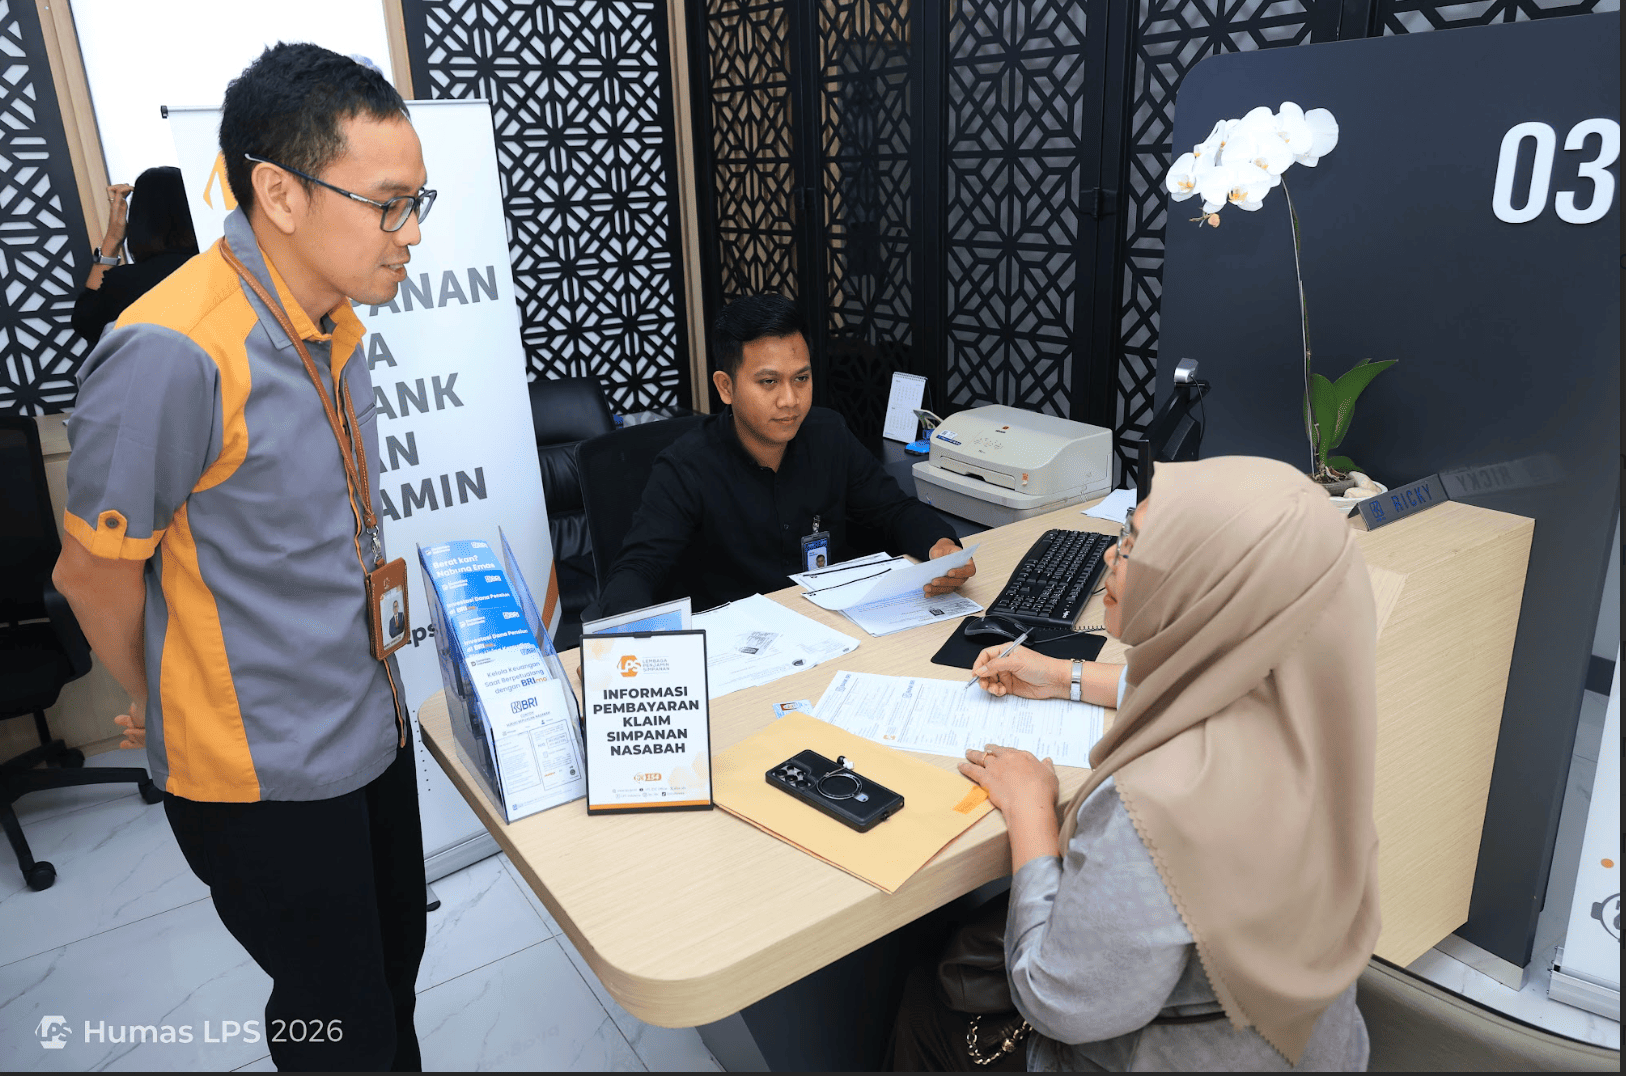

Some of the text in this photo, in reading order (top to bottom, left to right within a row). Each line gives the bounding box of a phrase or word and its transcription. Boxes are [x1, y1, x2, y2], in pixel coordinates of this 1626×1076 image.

[1492, 117, 1620, 224] 03
[1391, 484, 1433, 513] RICKY
[432, 555, 478, 569] Berat kan?
[486, 662, 541, 678] Kelola Keuangan
[617, 656, 641, 676] LPS
[484, 669, 545, 687] Saat Berpetualang
[494, 683, 521, 694] dengan
[603, 686, 688, 700] INFORMASI
[521, 696, 539, 710] BRI
[593, 700, 699, 714] PEMBAYARAN
[622, 715, 671, 727] KLAIM
[607, 729, 688, 742] SIMPANAN
[610, 743, 686, 756] NASABAH
